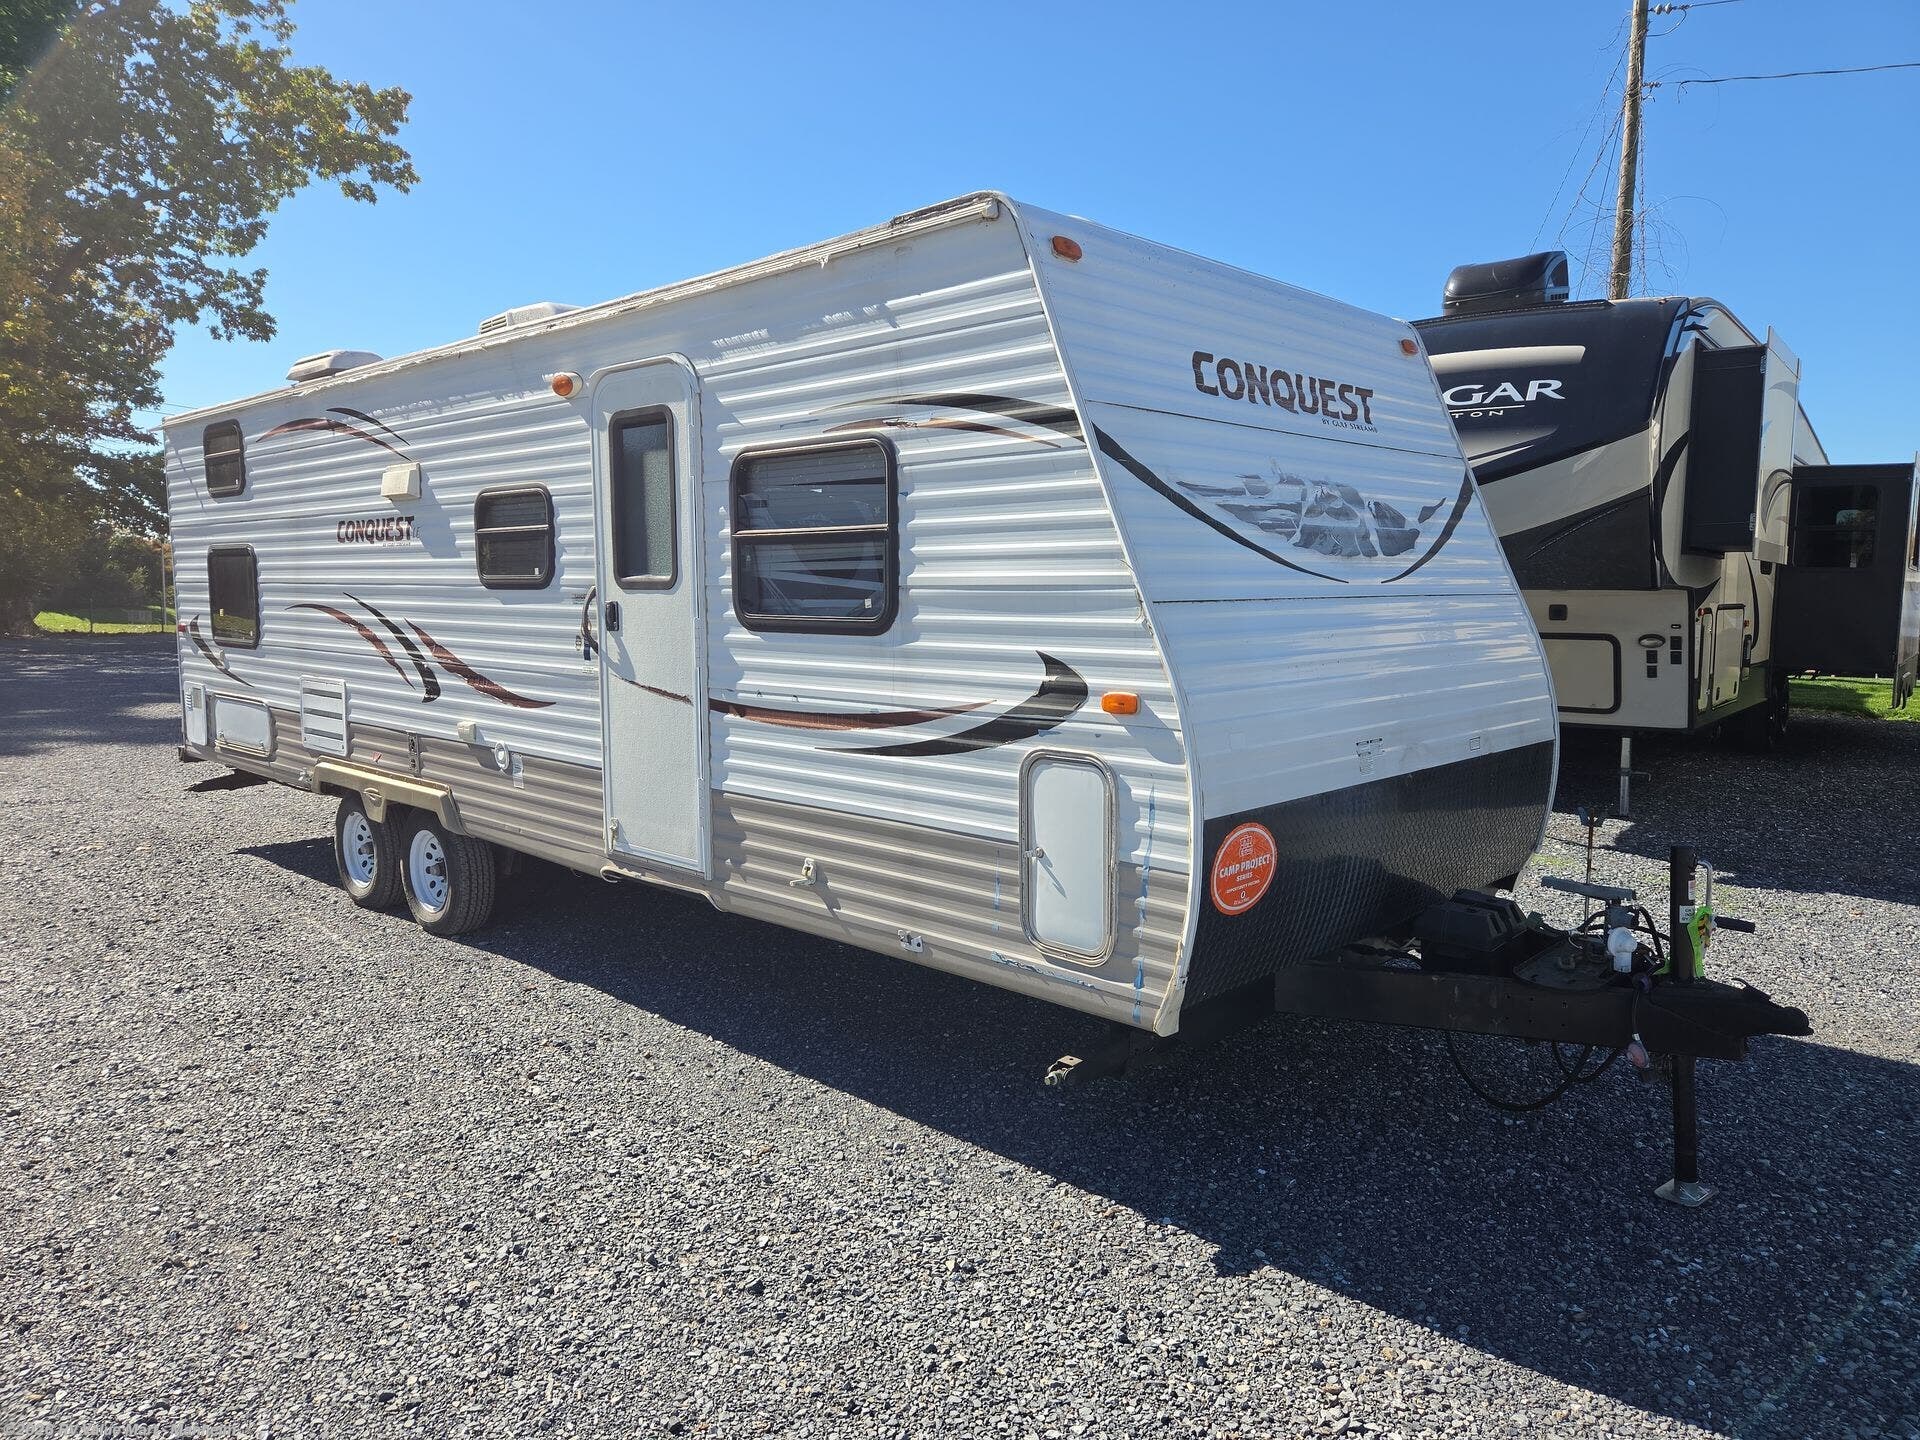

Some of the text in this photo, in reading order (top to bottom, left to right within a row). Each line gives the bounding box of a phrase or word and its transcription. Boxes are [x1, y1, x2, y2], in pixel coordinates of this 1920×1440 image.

[1192, 351, 1374, 425] CONQUEST
[1451, 410, 1504, 419] TON
[337, 515, 415, 544] CONQUEST
[1220, 853, 1271, 879] CAMP PROJECT
